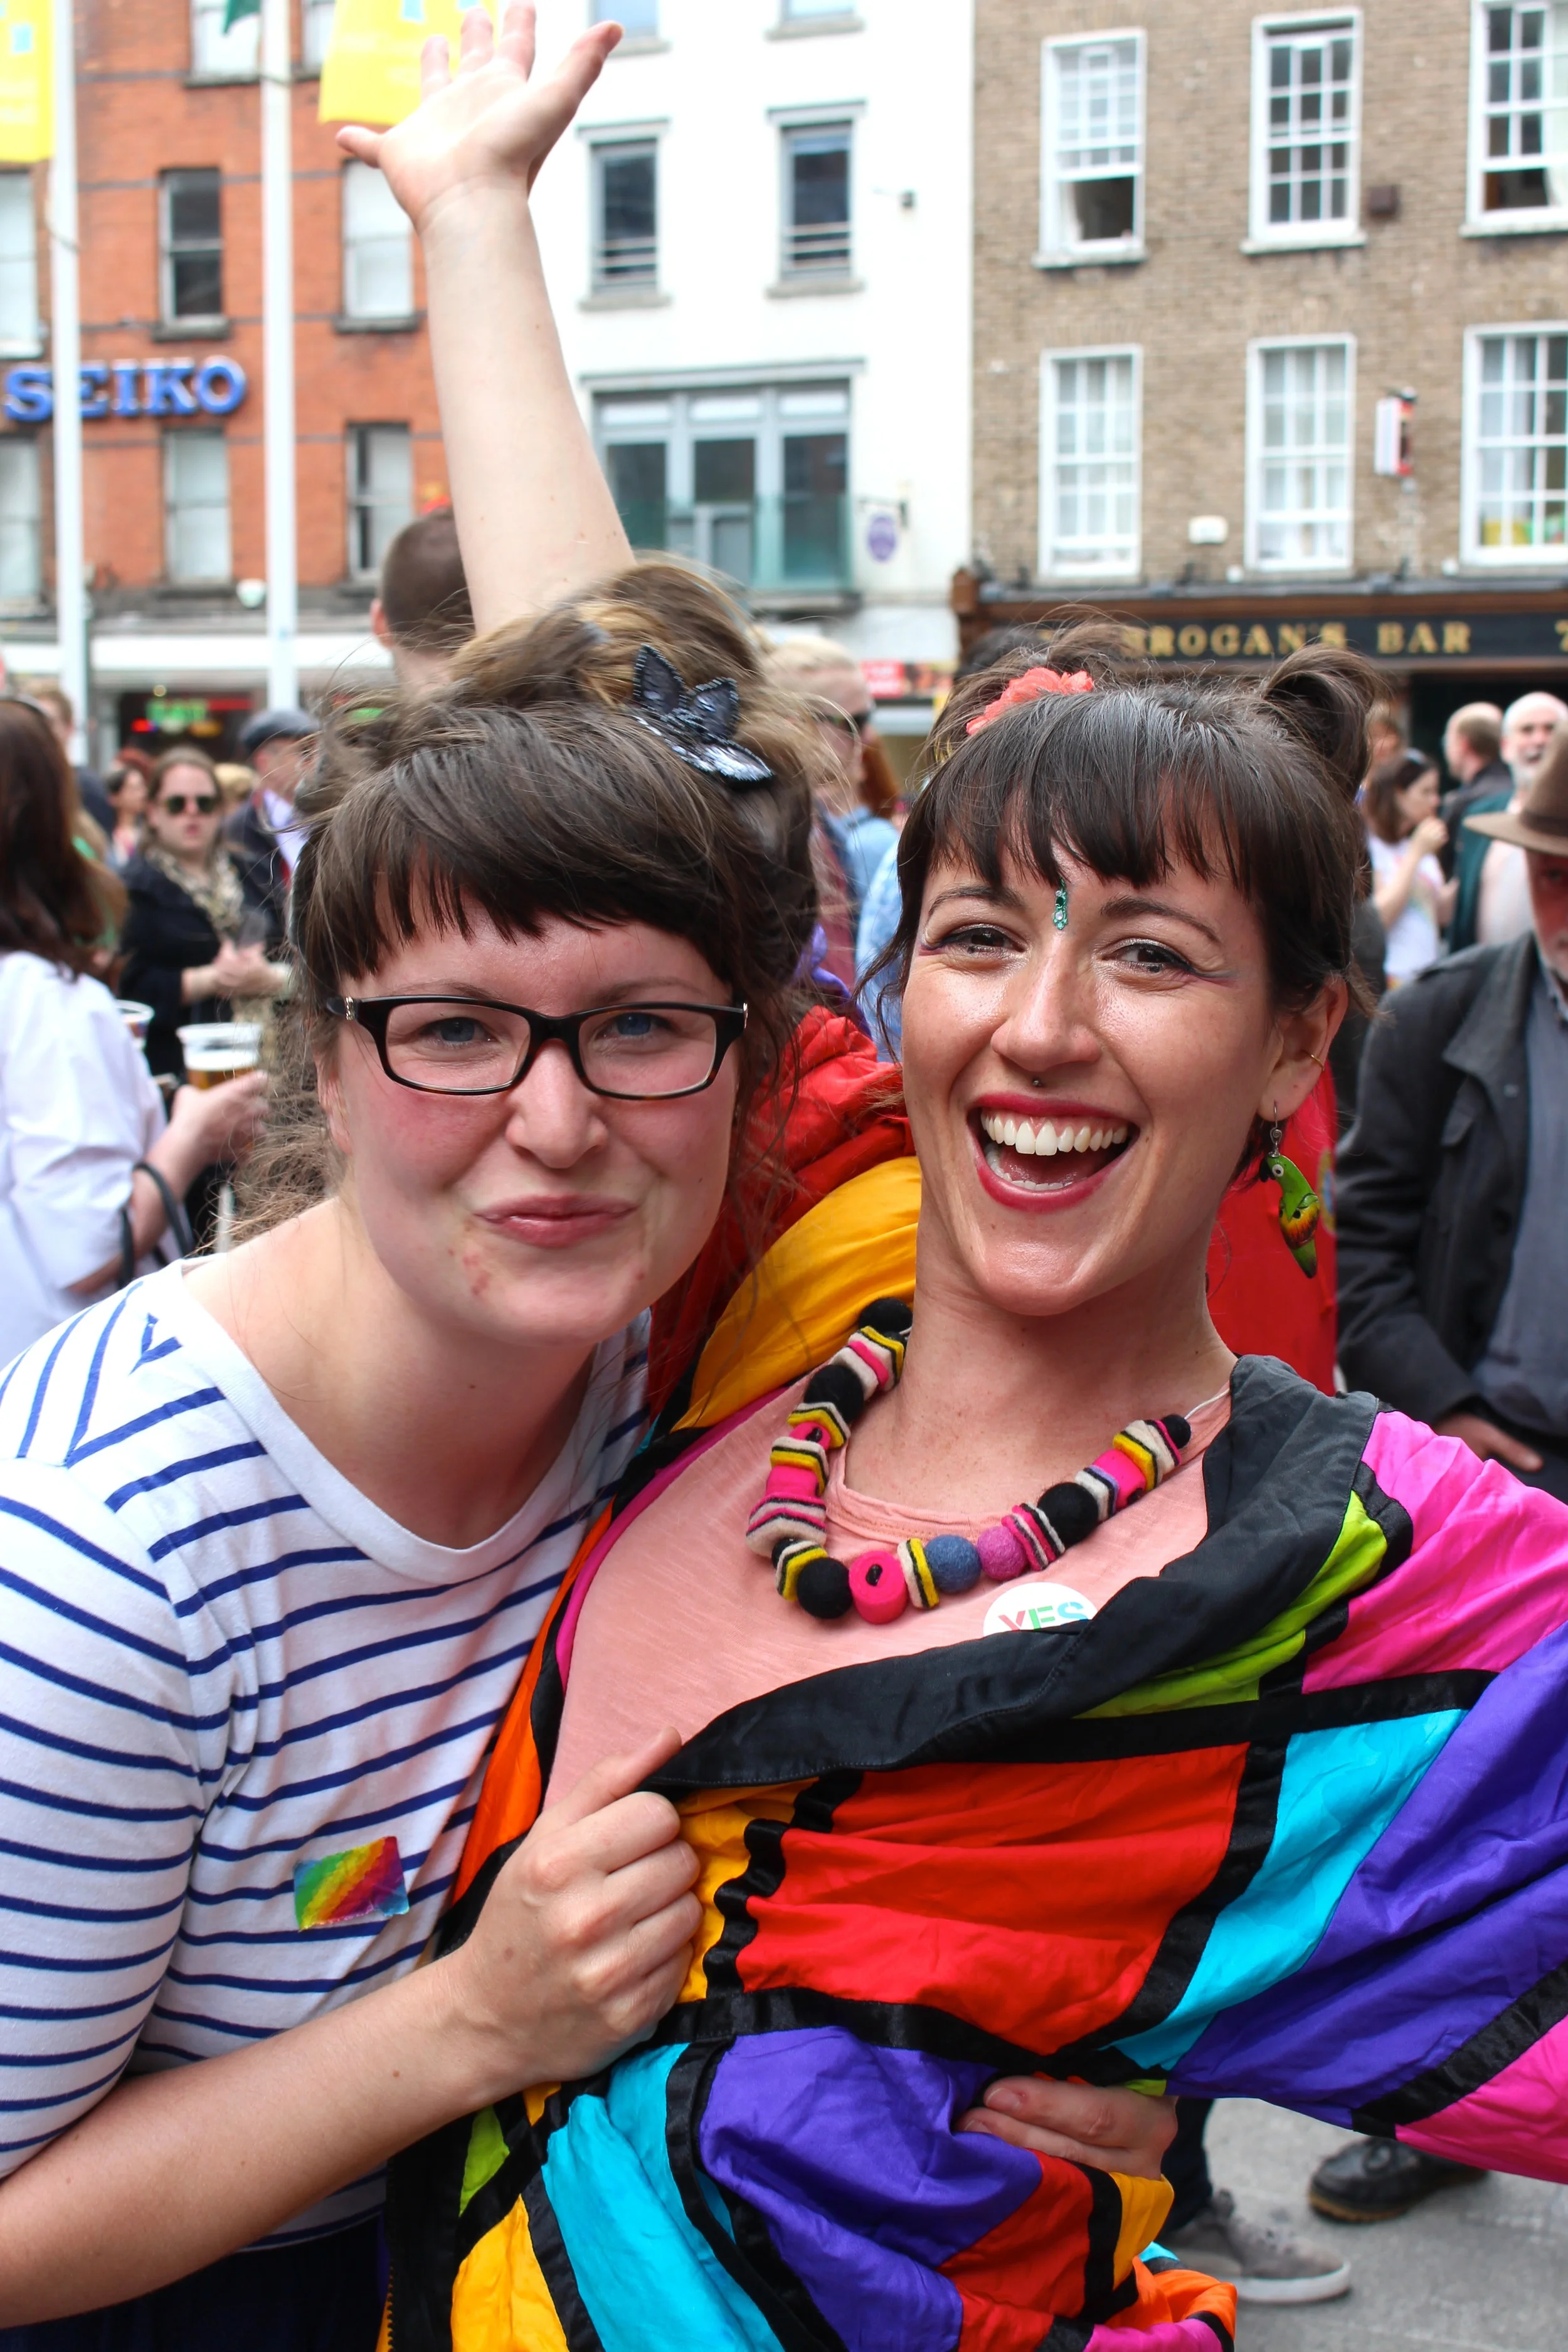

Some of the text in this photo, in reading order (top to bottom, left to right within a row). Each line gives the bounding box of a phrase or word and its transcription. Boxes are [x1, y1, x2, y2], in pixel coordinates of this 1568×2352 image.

[4, 356, 246, 421] SEIKO
[1377, 621, 1471, 654] BAR
[998, 1601, 1089, 1631] YES
